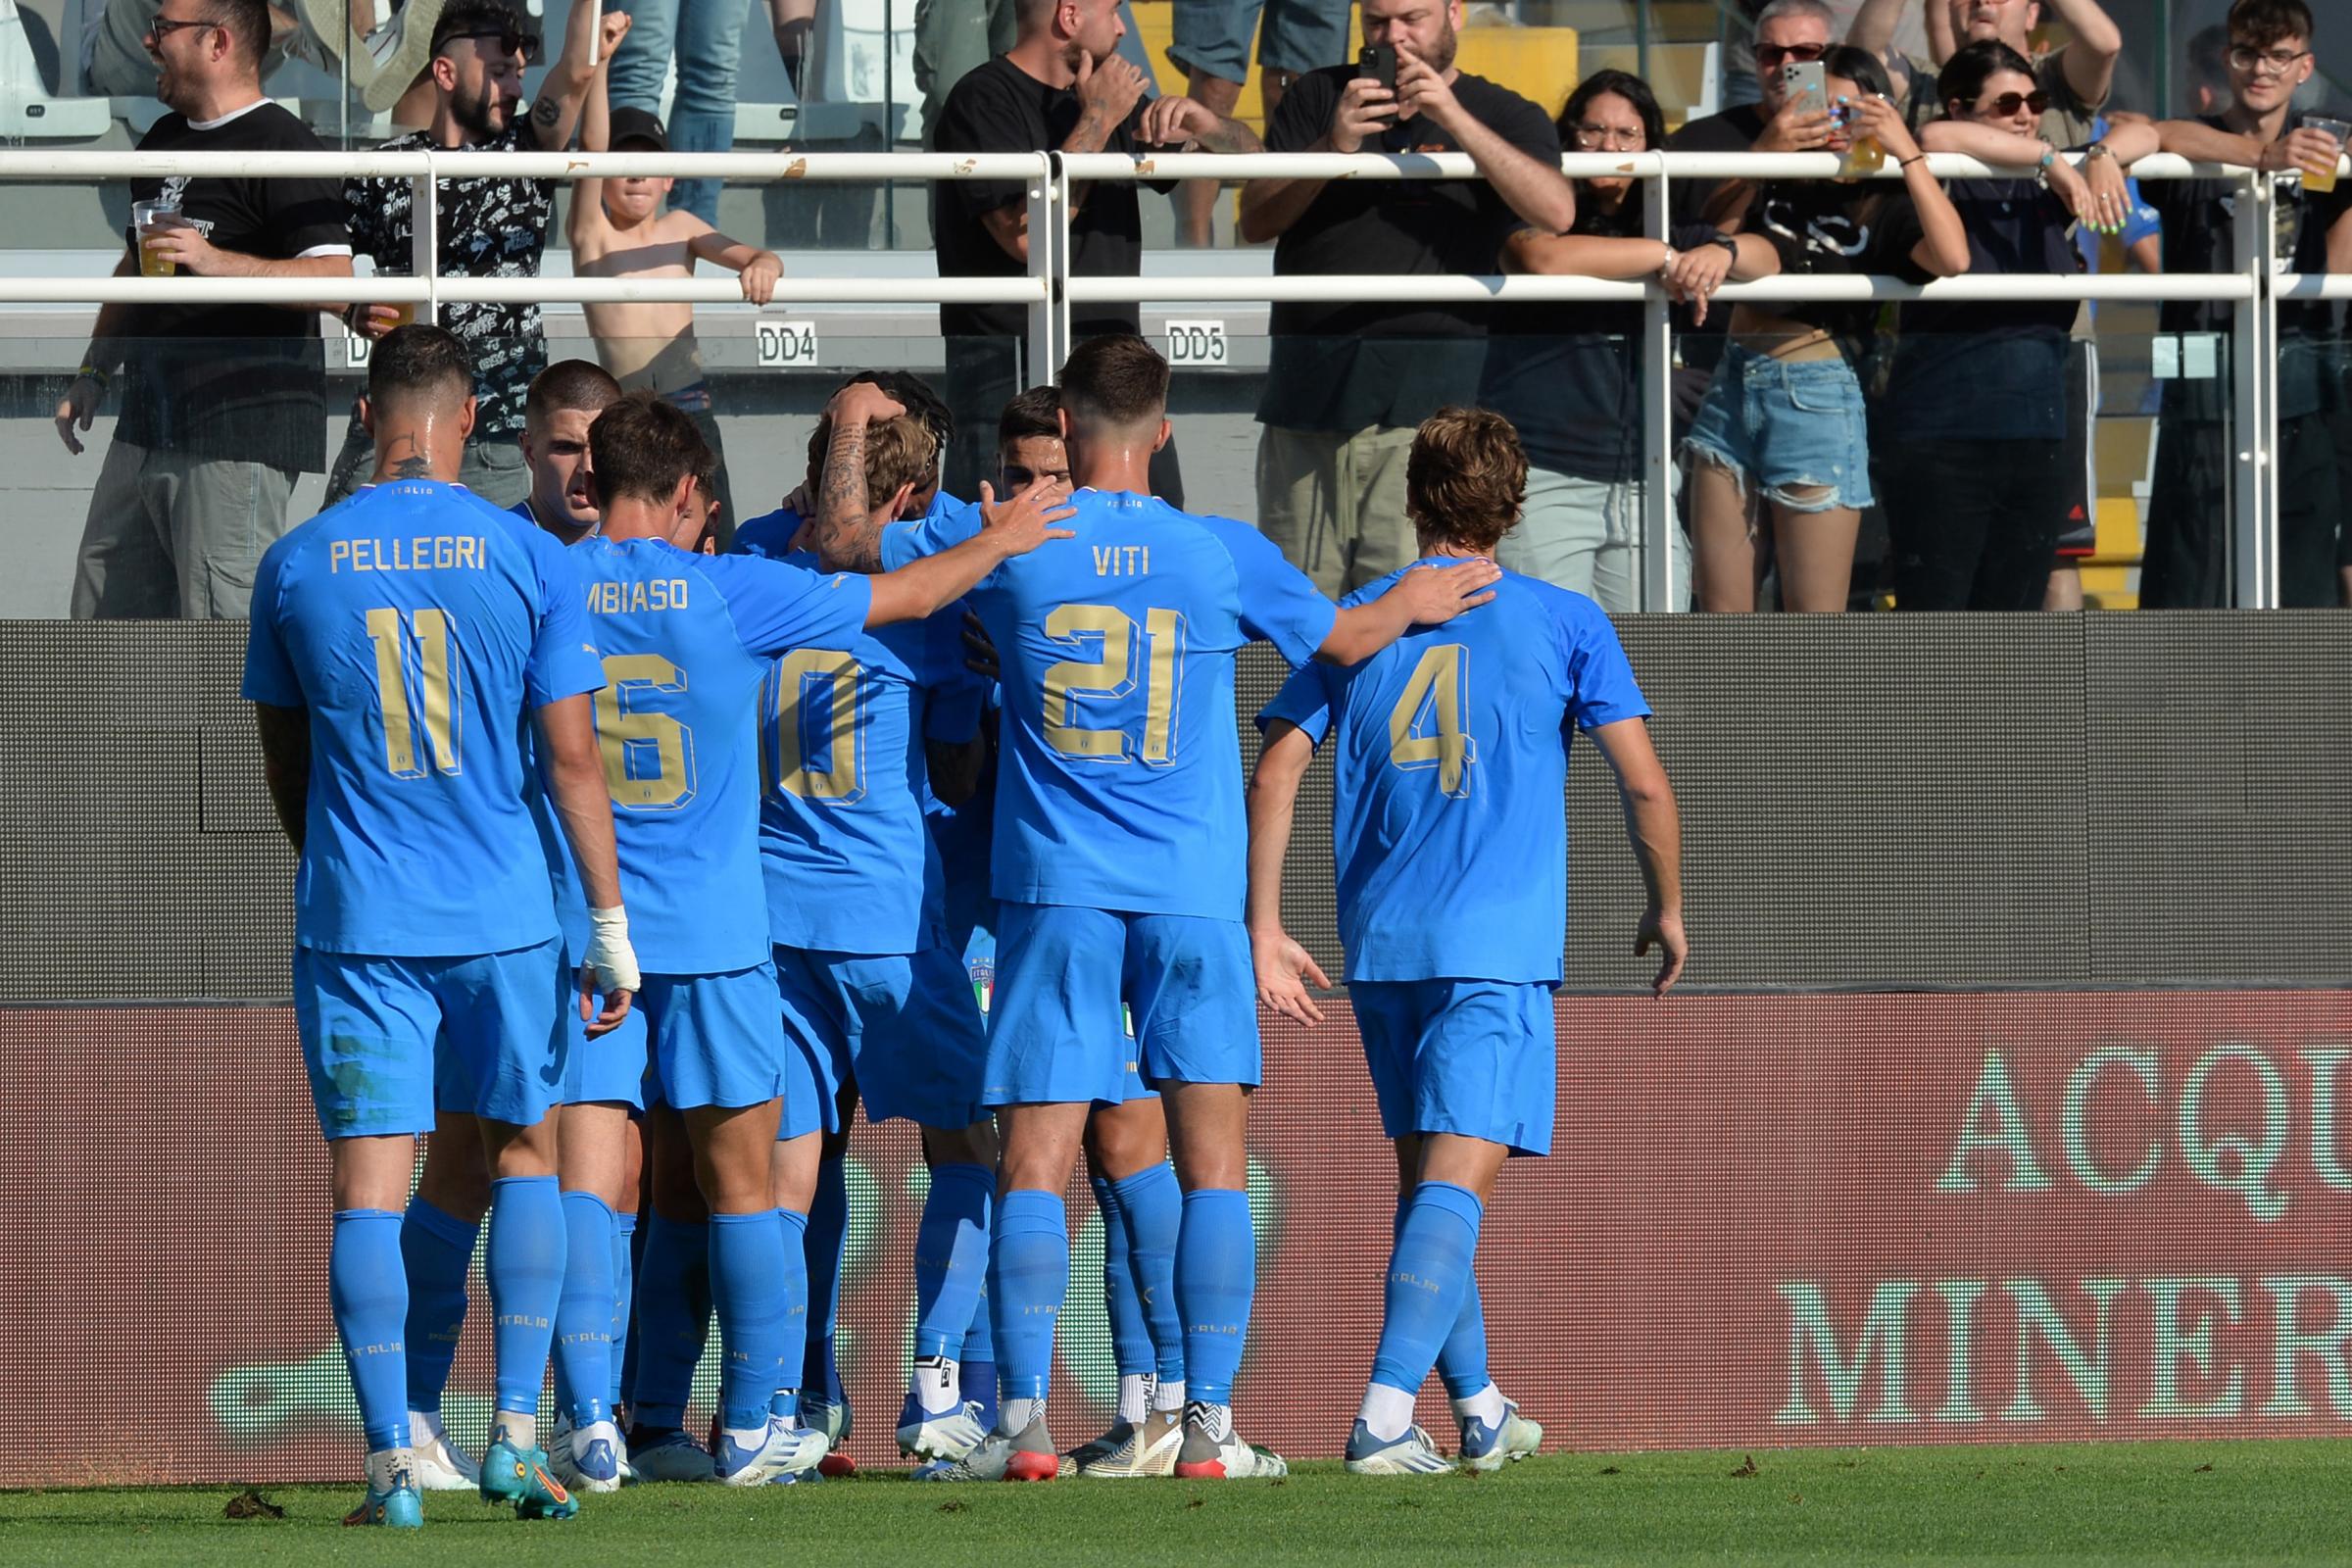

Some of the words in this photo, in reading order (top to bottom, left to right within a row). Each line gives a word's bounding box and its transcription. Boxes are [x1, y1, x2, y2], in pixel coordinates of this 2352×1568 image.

[760, 326, 814, 361] DD4
[1169, 326, 1224, 361] DD5
[330, 536, 485, 574] PELLEGRI
[1092, 545, 1150, 576] VITI
[366, 608, 462, 779] 11
[1043, 604, 1187, 767] 21
[593, 654, 697, 811] 6
[1389, 643, 1476, 799] 4
[499, 1314, 549, 1329] ITALIA
[349, 1342, 402, 1358] ITALIA
[1773, 1277, 2352, 1423] MINER
